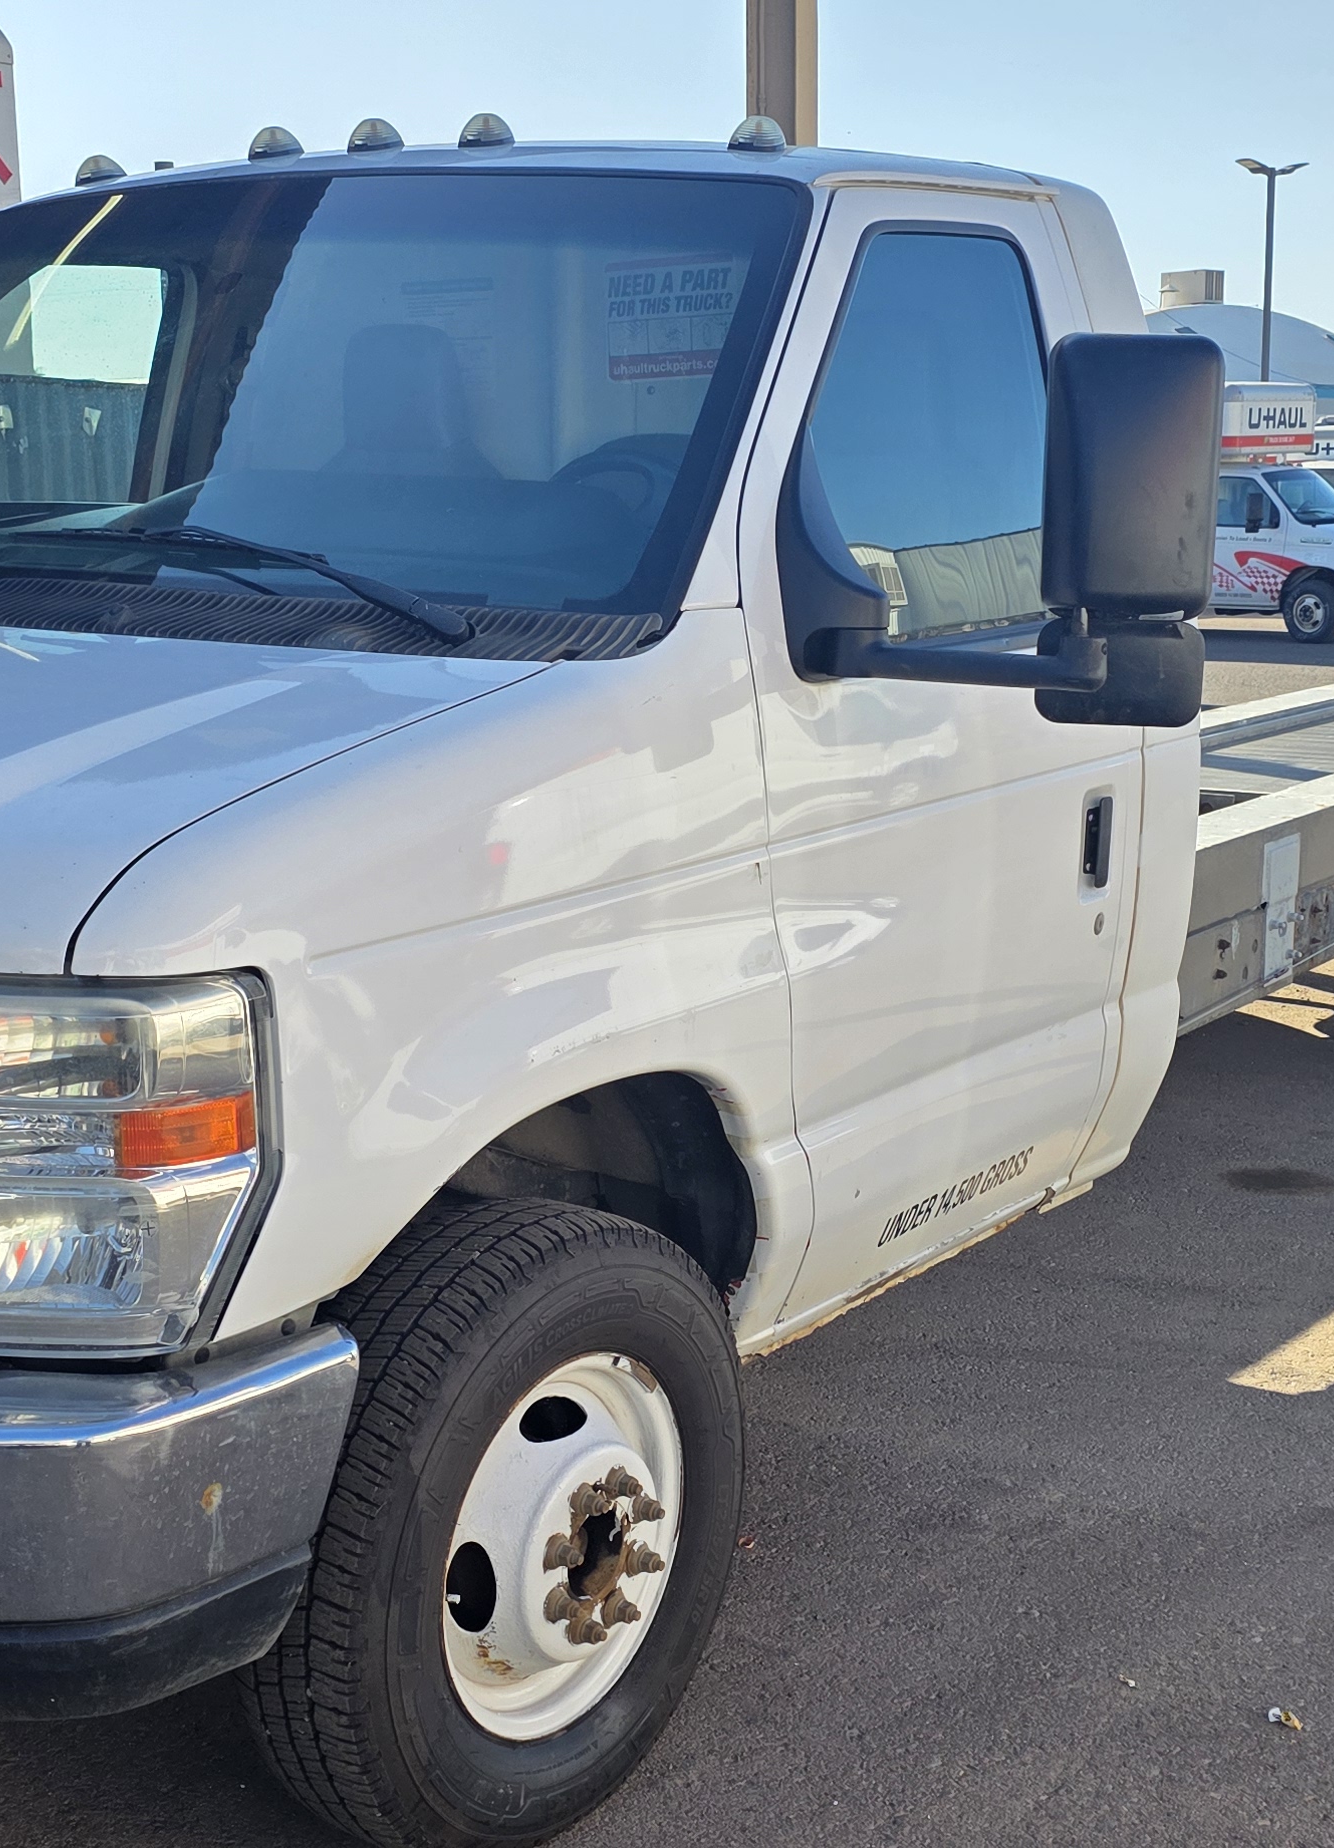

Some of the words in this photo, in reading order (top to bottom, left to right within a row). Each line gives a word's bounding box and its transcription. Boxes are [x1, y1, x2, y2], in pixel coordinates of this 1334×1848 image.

[608, 272, 656, 299] NEED
[660, 271, 674, 294] A
[679, 266, 732, 293] PART
[608, 299, 636, 319] FOR
[638, 296, 672, 316] THIS
[674, 292, 734, 314] TRUCK?
[1247, 406, 1308, 430] U-HAUL
[877, 1193, 939, 1248] UNDER
[934, 1171, 984, 1218] 14,500
[979, 1146, 1035, 1195] GROSS
[492, 1339, 544, 1399] AGILIS
